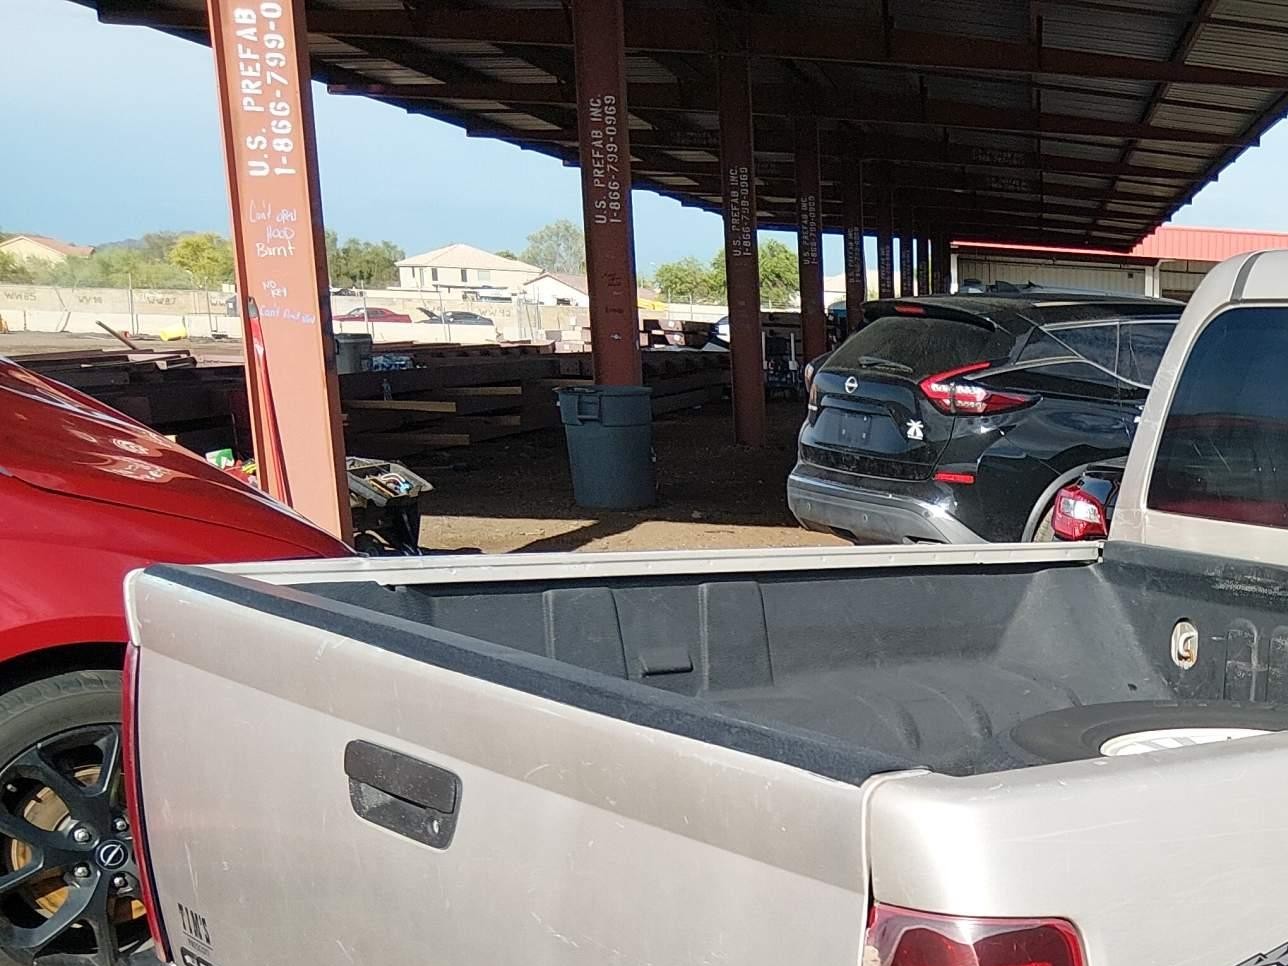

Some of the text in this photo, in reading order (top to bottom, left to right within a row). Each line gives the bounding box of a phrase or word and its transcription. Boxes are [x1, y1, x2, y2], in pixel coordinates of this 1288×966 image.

[233, 7, 270, 176] U.S. PREFAB
[592, 130, 605, 188] PREFAB
[603, 95, 622, 224] 1-866-799-0969
[594, 194, 608, 224] U.S.
